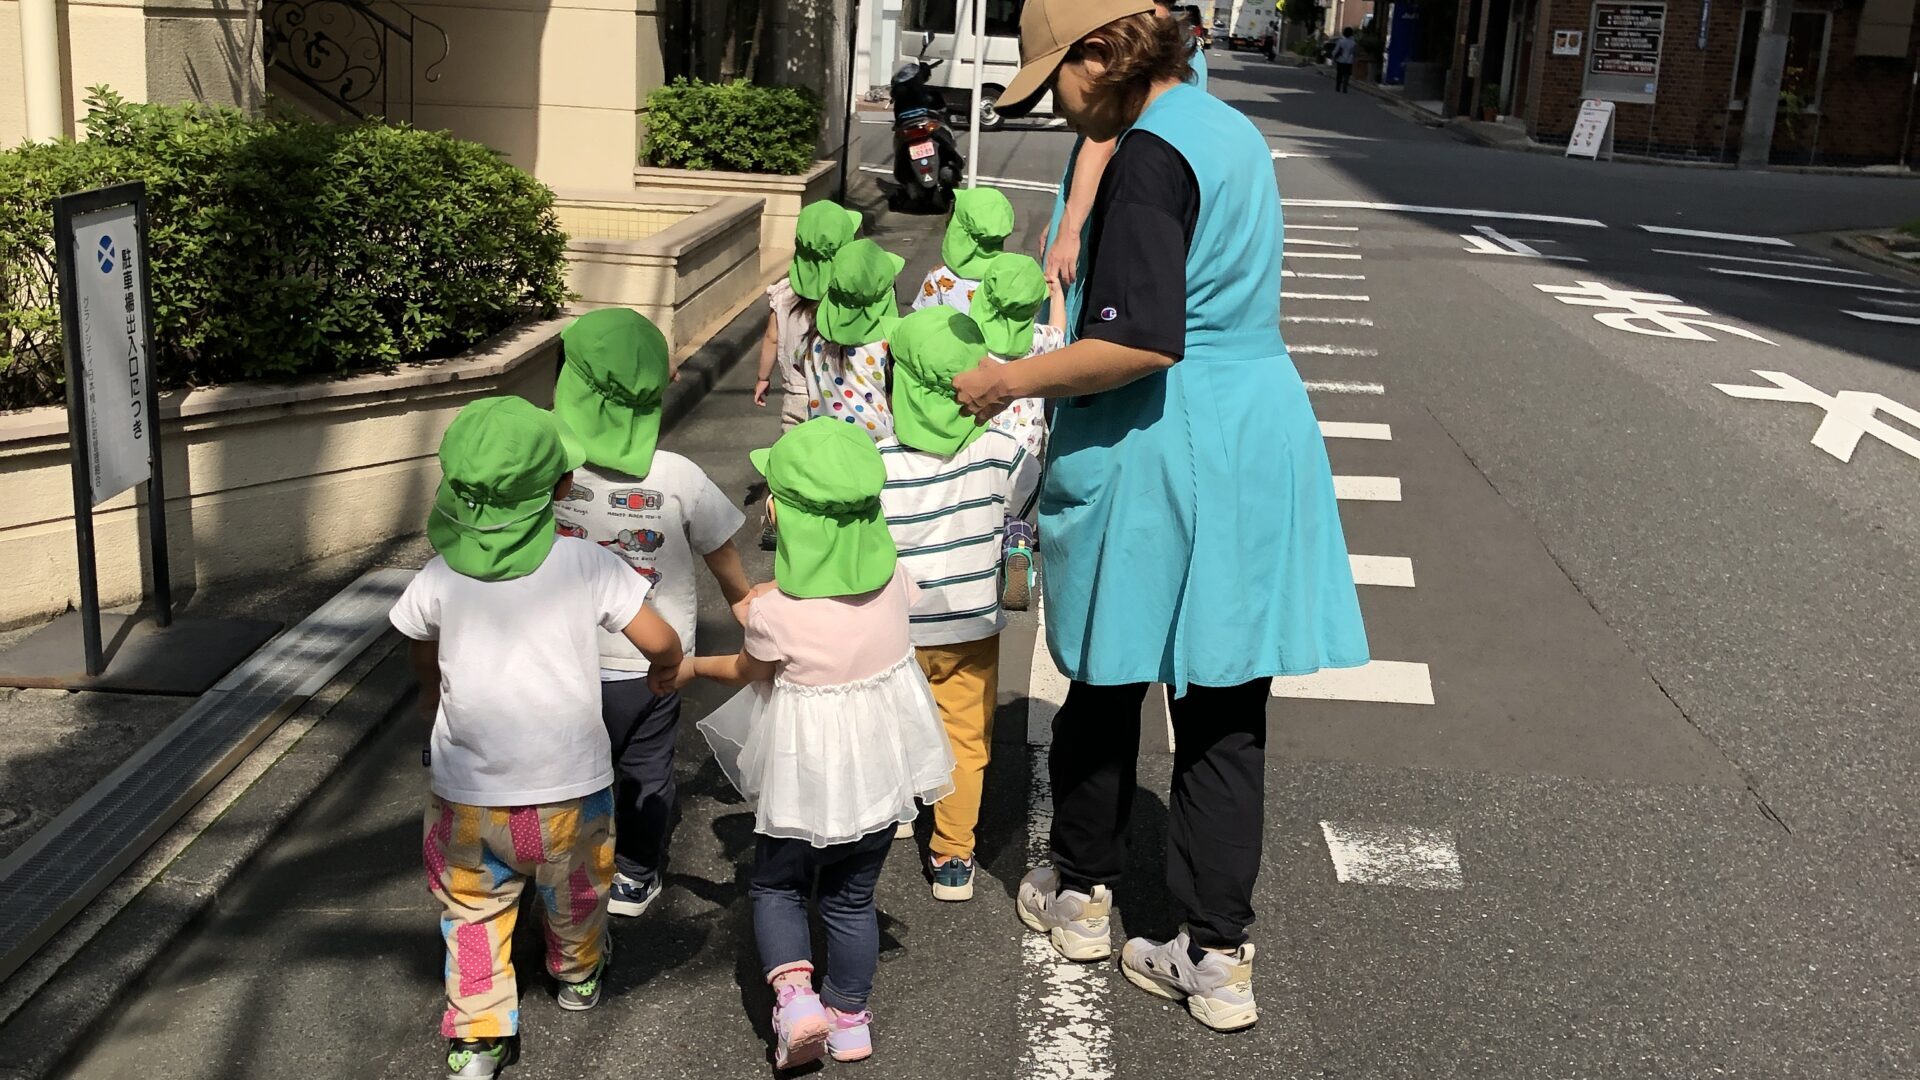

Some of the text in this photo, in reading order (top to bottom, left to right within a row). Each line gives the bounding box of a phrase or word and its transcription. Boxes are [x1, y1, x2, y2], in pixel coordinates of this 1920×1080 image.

[121, 248, 142, 439] 駐車場出入口につき
